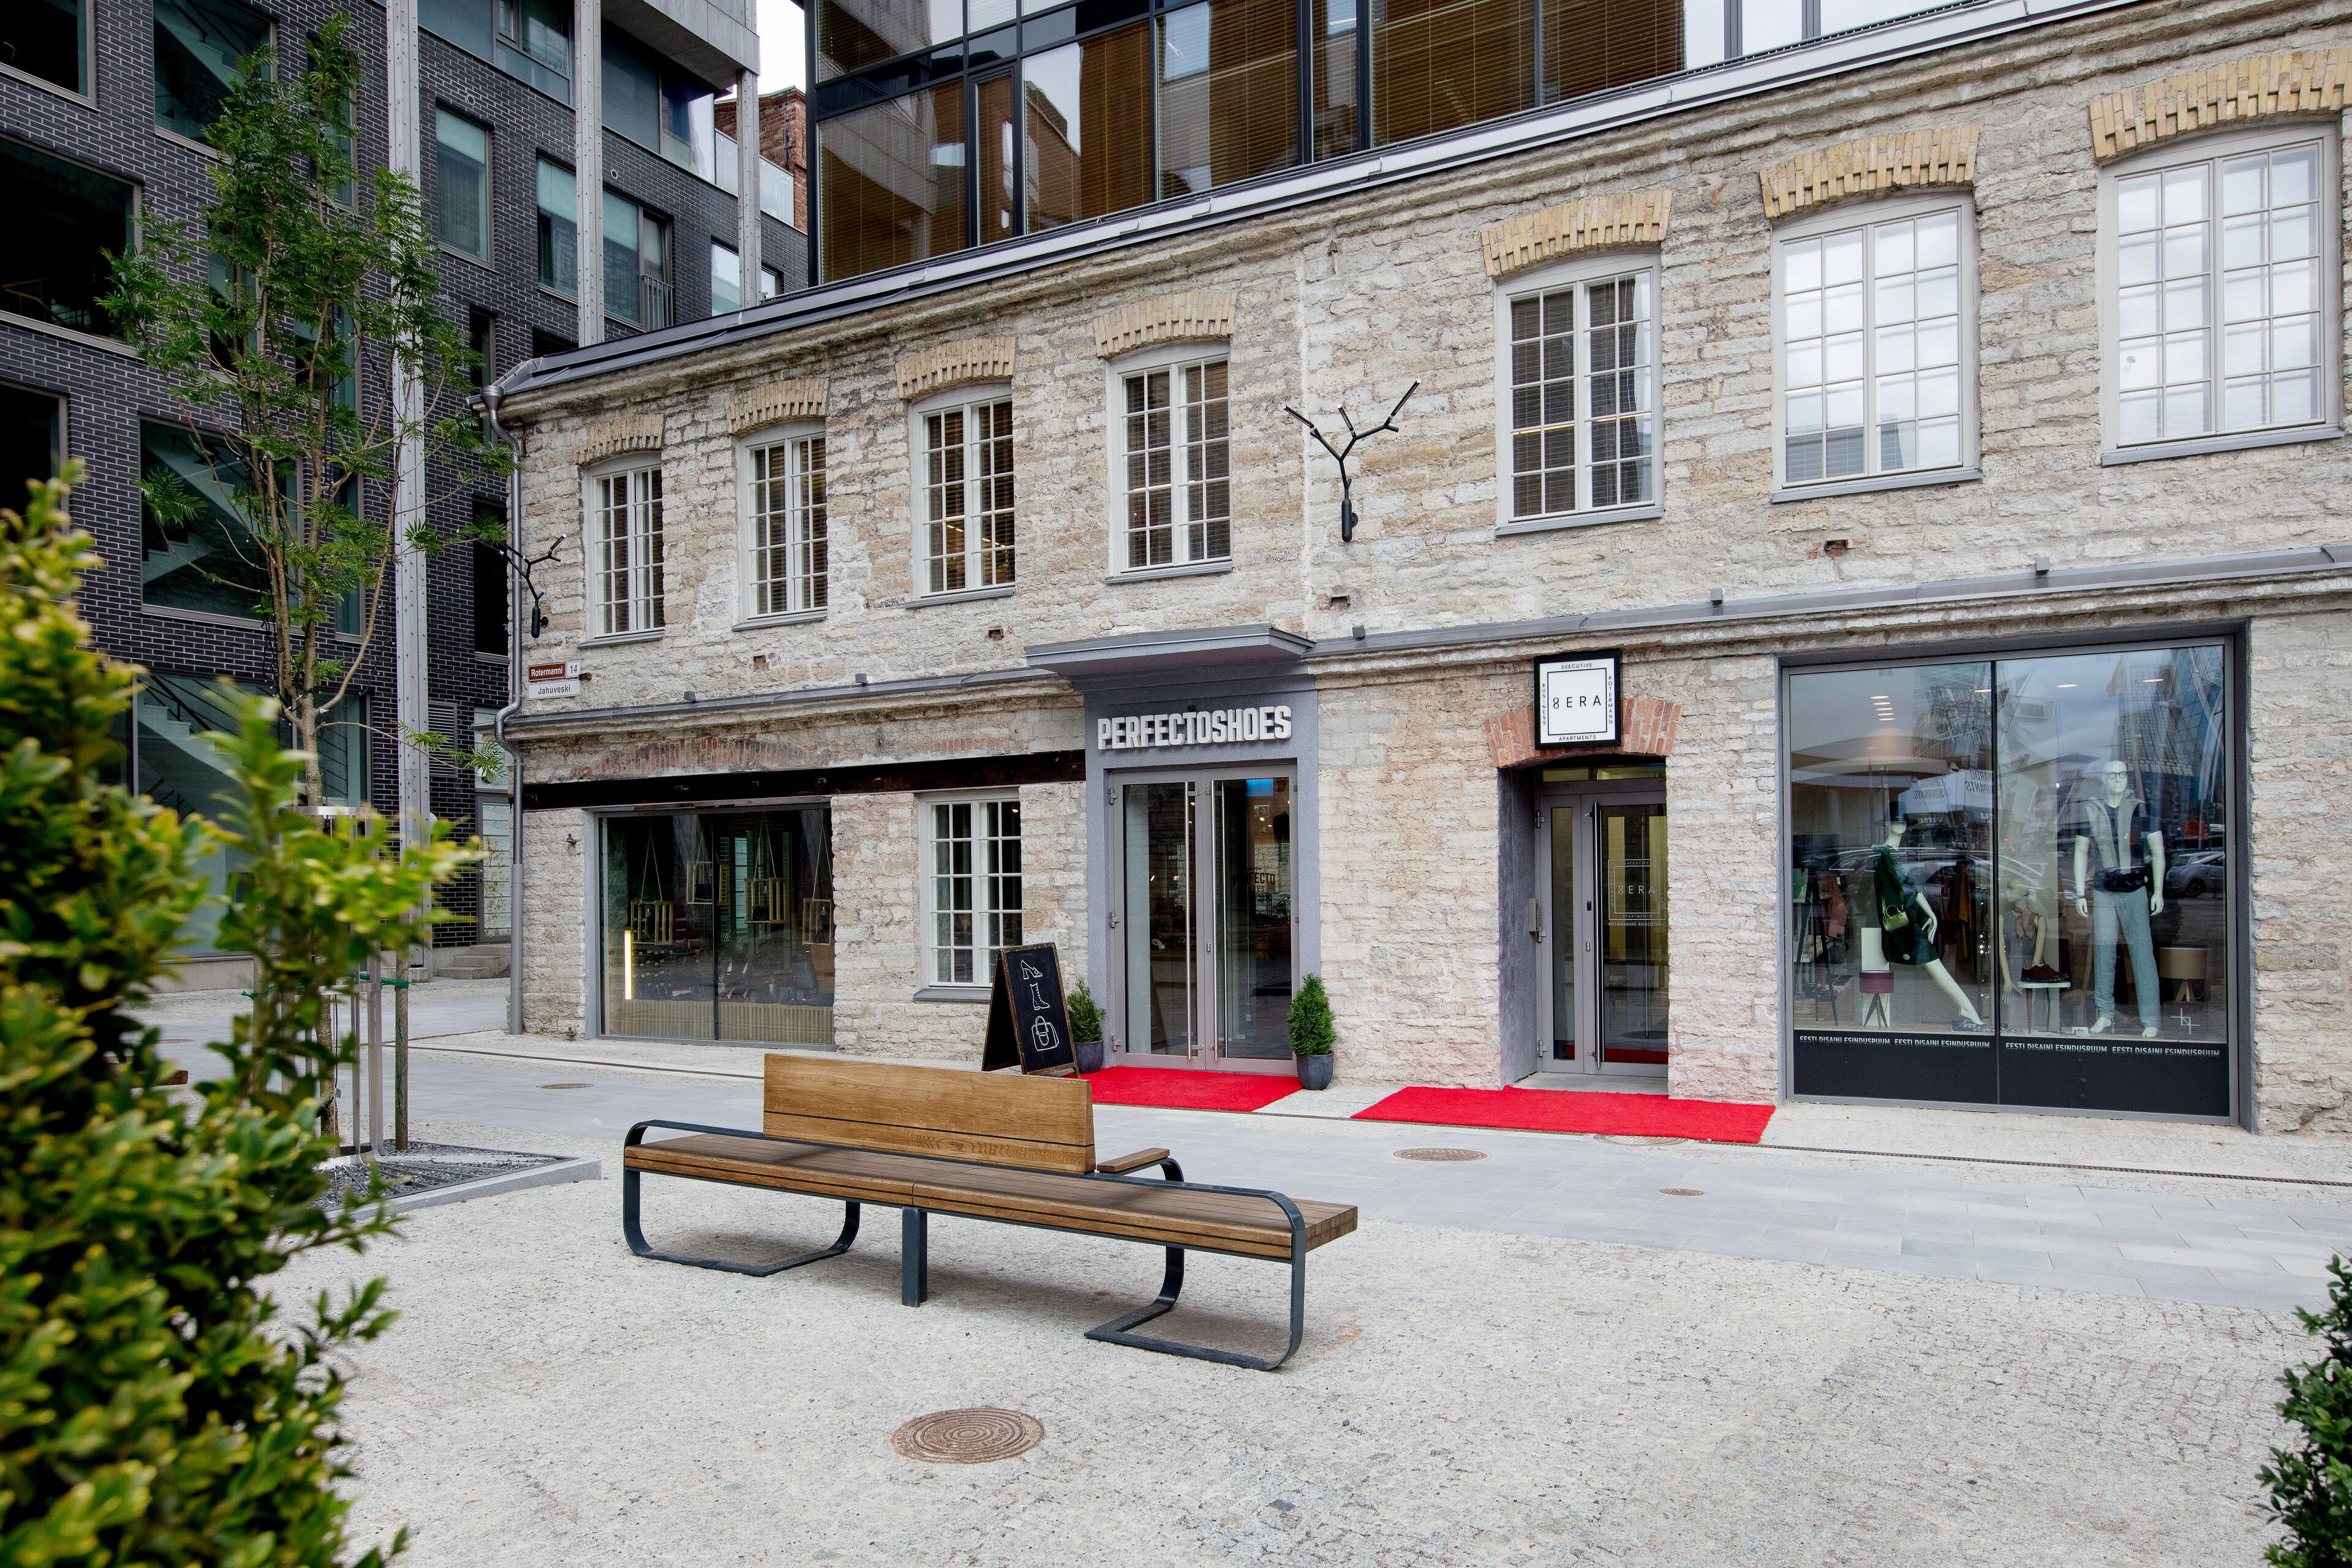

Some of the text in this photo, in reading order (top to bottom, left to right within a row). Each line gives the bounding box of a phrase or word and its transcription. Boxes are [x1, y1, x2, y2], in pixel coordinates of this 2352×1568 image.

[531, 665, 578, 677] Rotermanni 14
[538, 684, 571, 695] Jahuveski
[1553, 695, 1601, 709] 8ERA
[1098, 705, 1292, 750] PERFECTOSHOES
[2055, 1044, 2107, 1053] ESINDUSRUUM
